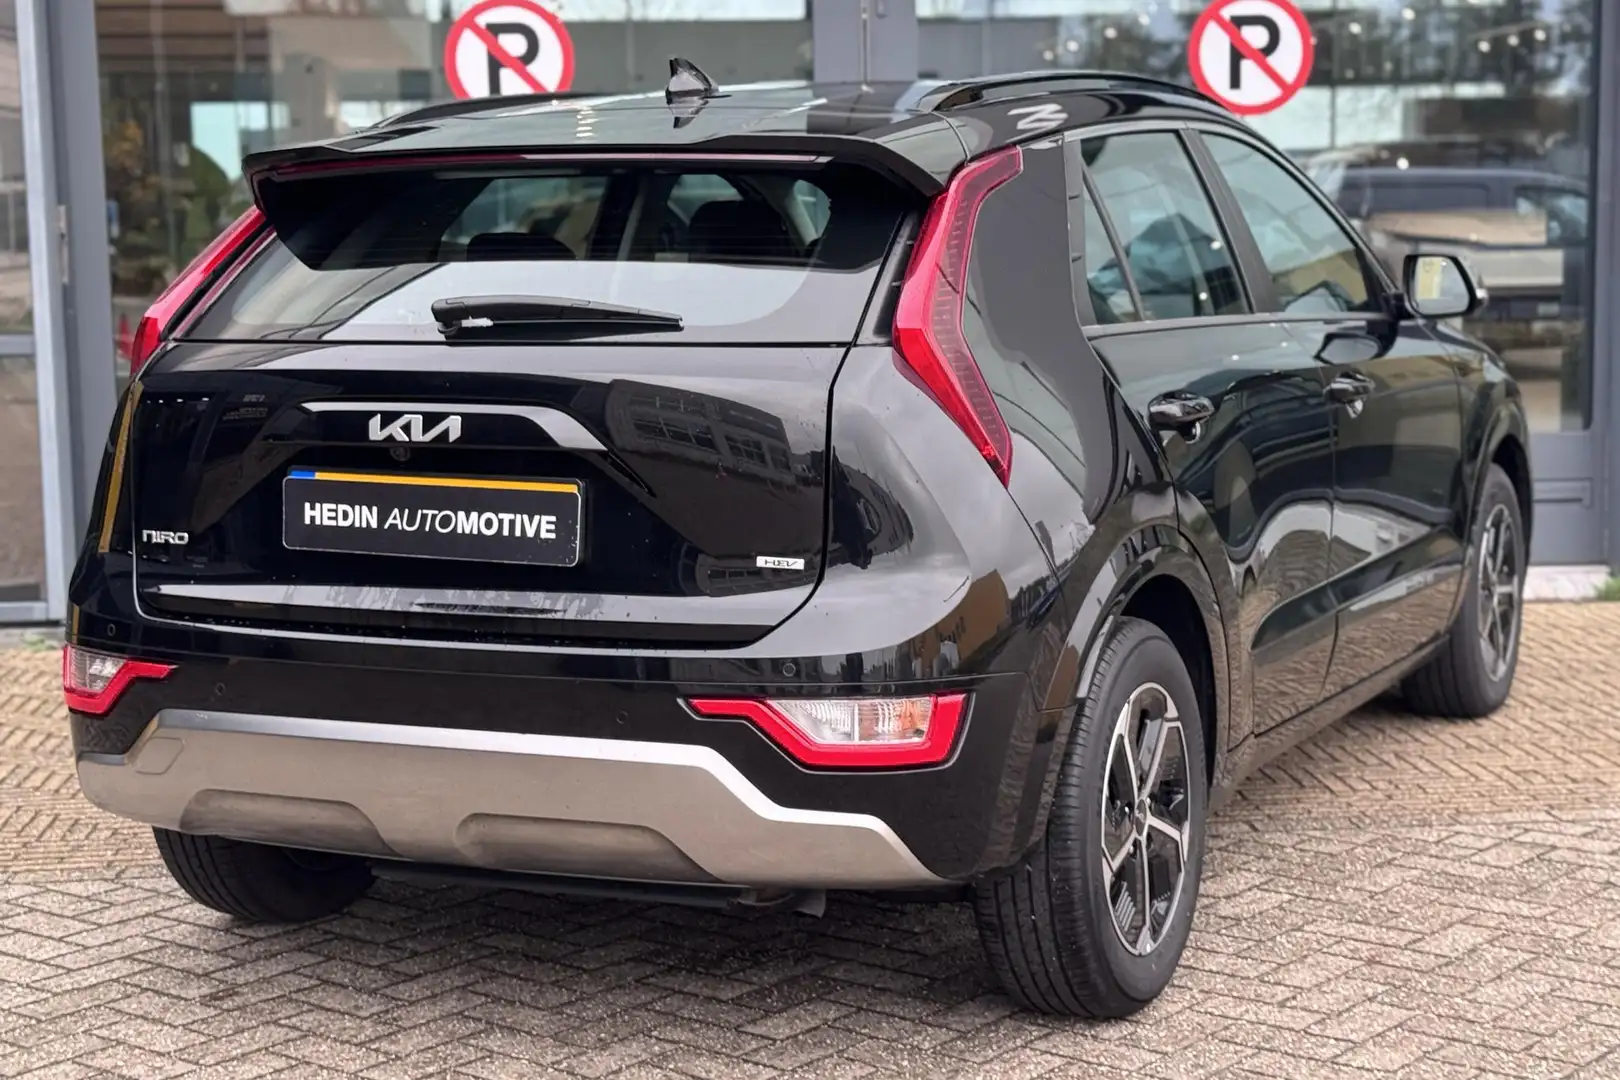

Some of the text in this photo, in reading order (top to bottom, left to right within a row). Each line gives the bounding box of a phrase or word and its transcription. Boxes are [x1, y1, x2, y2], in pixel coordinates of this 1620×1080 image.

[485, 22, 540, 96] P
[1229, 14, 1281, 90] P
[368, 413, 462, 443] KIA
[142, 529, 189, 545] NIRO
[303, 502, 557, 539] HEDIN AUTOMOTIVE
